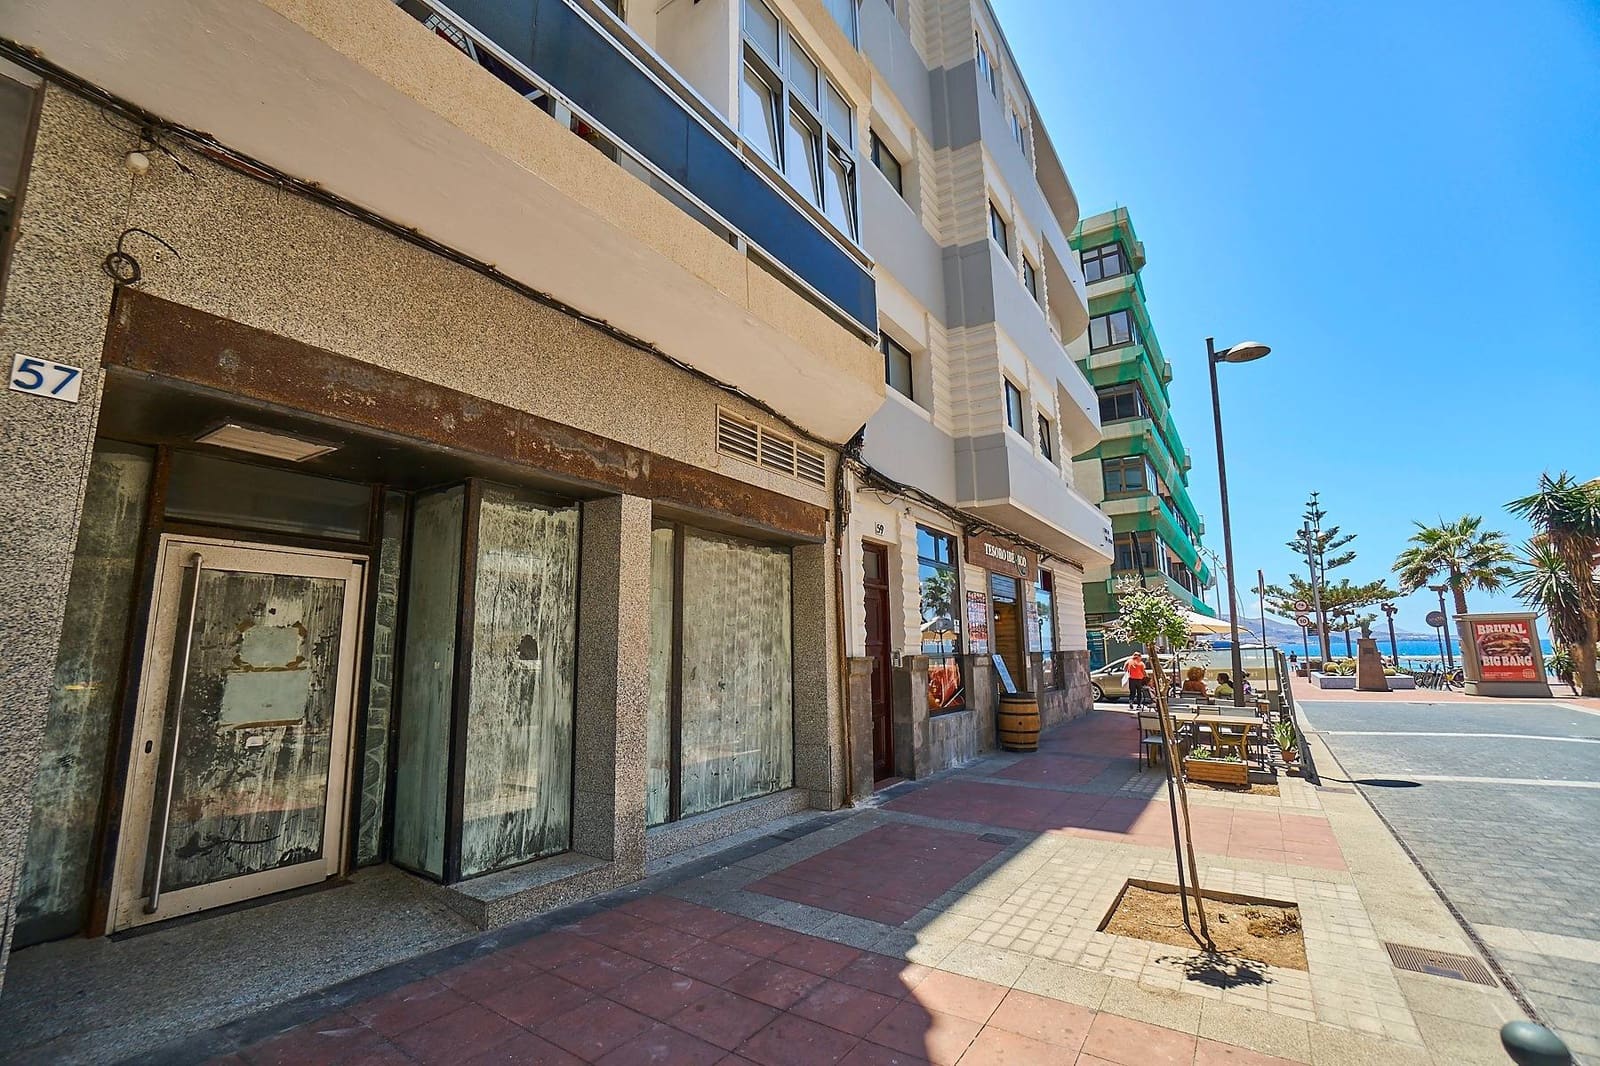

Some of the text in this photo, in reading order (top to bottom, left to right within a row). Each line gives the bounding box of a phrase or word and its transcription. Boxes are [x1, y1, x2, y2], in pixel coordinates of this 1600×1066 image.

[13, 358, 80, 395] 57
[876, 523, 885, 535] 59
[984, 542, 1006, 560] TESORO
[1476, 623, 1527, 635] BRUTAL
[1481, 655, 1533, 667] BIG BANG
